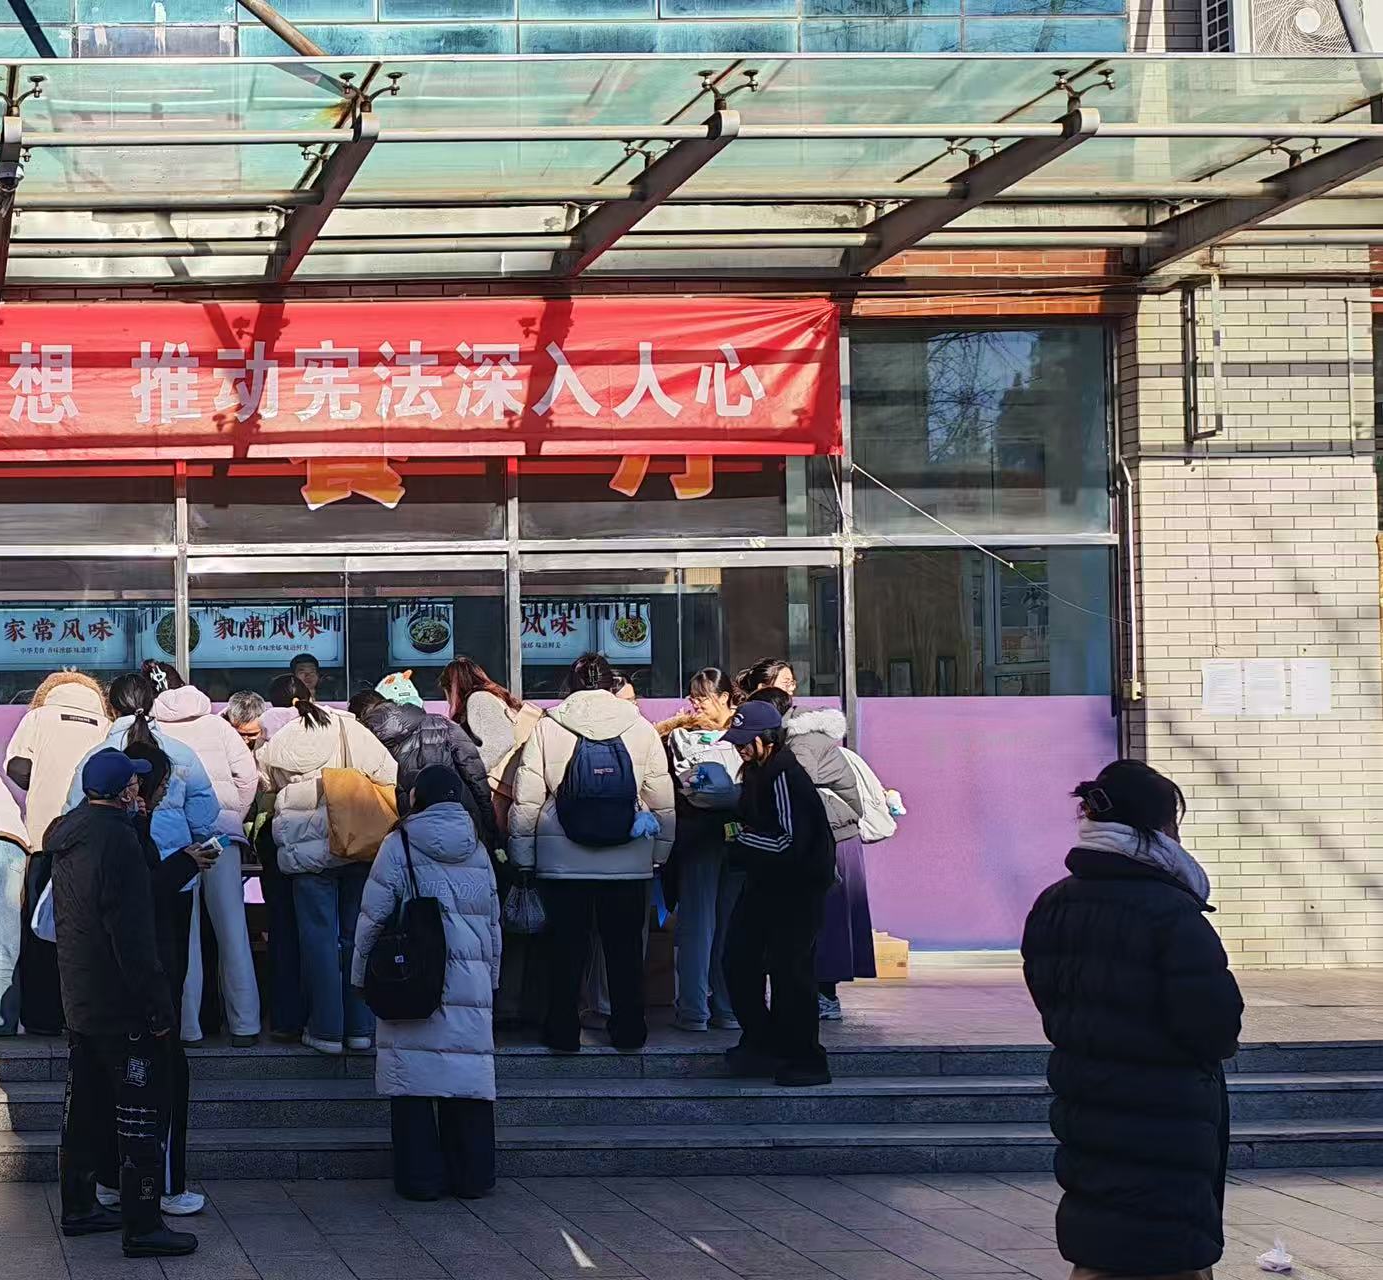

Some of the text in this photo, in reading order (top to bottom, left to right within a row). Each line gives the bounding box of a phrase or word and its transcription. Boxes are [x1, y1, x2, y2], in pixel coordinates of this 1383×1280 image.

[130, 339, 765, 423] 推动宪法深入人心
[3, 617, 114, 643] 家常风味
[213, 615, 327, 640] 家常风味
